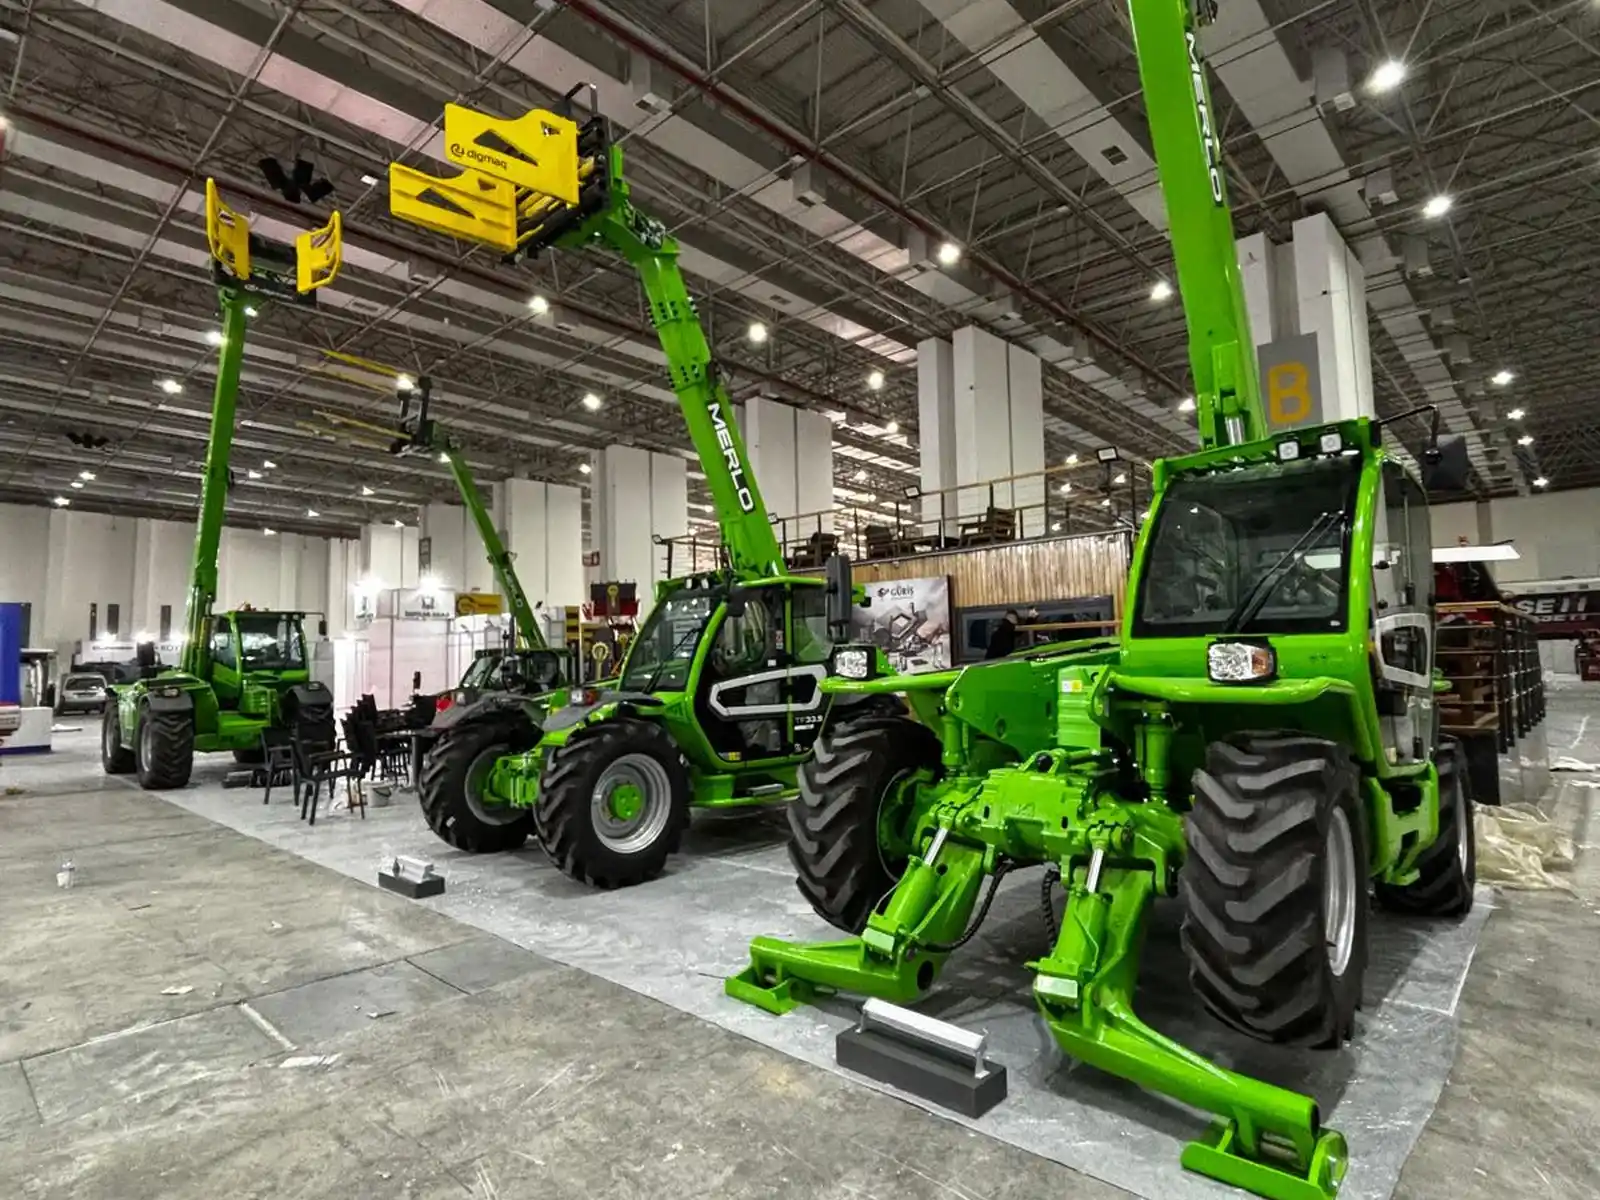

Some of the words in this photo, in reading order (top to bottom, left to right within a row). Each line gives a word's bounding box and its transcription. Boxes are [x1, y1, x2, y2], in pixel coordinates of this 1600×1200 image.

[1185, 31, 1222, 202] MERLO
[466, 149, 508, 171] digmaq
[1268, 362, 1312, 424] B
[707, 402, 754, 512] MERLO
